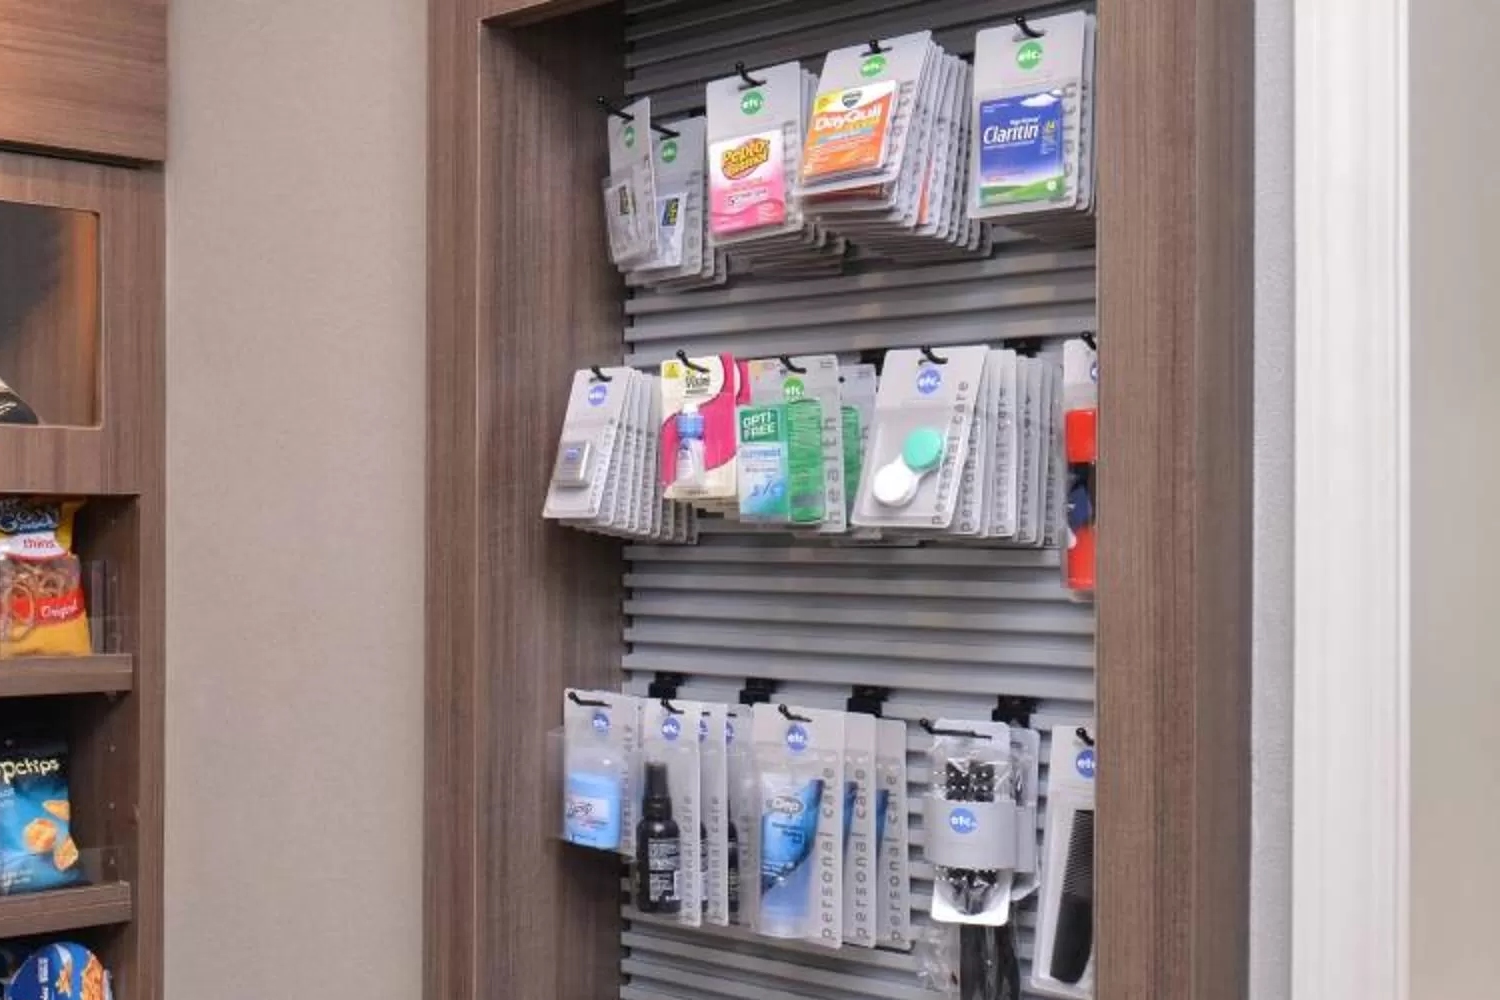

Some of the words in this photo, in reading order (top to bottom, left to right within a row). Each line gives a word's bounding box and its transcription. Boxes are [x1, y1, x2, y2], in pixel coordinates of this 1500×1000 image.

[983, 120, 1040, 145] Claritin
[823, 767, 836, 819] care
[822, 831, 834, 941] personal
[855, 831, 868, 941] personal
